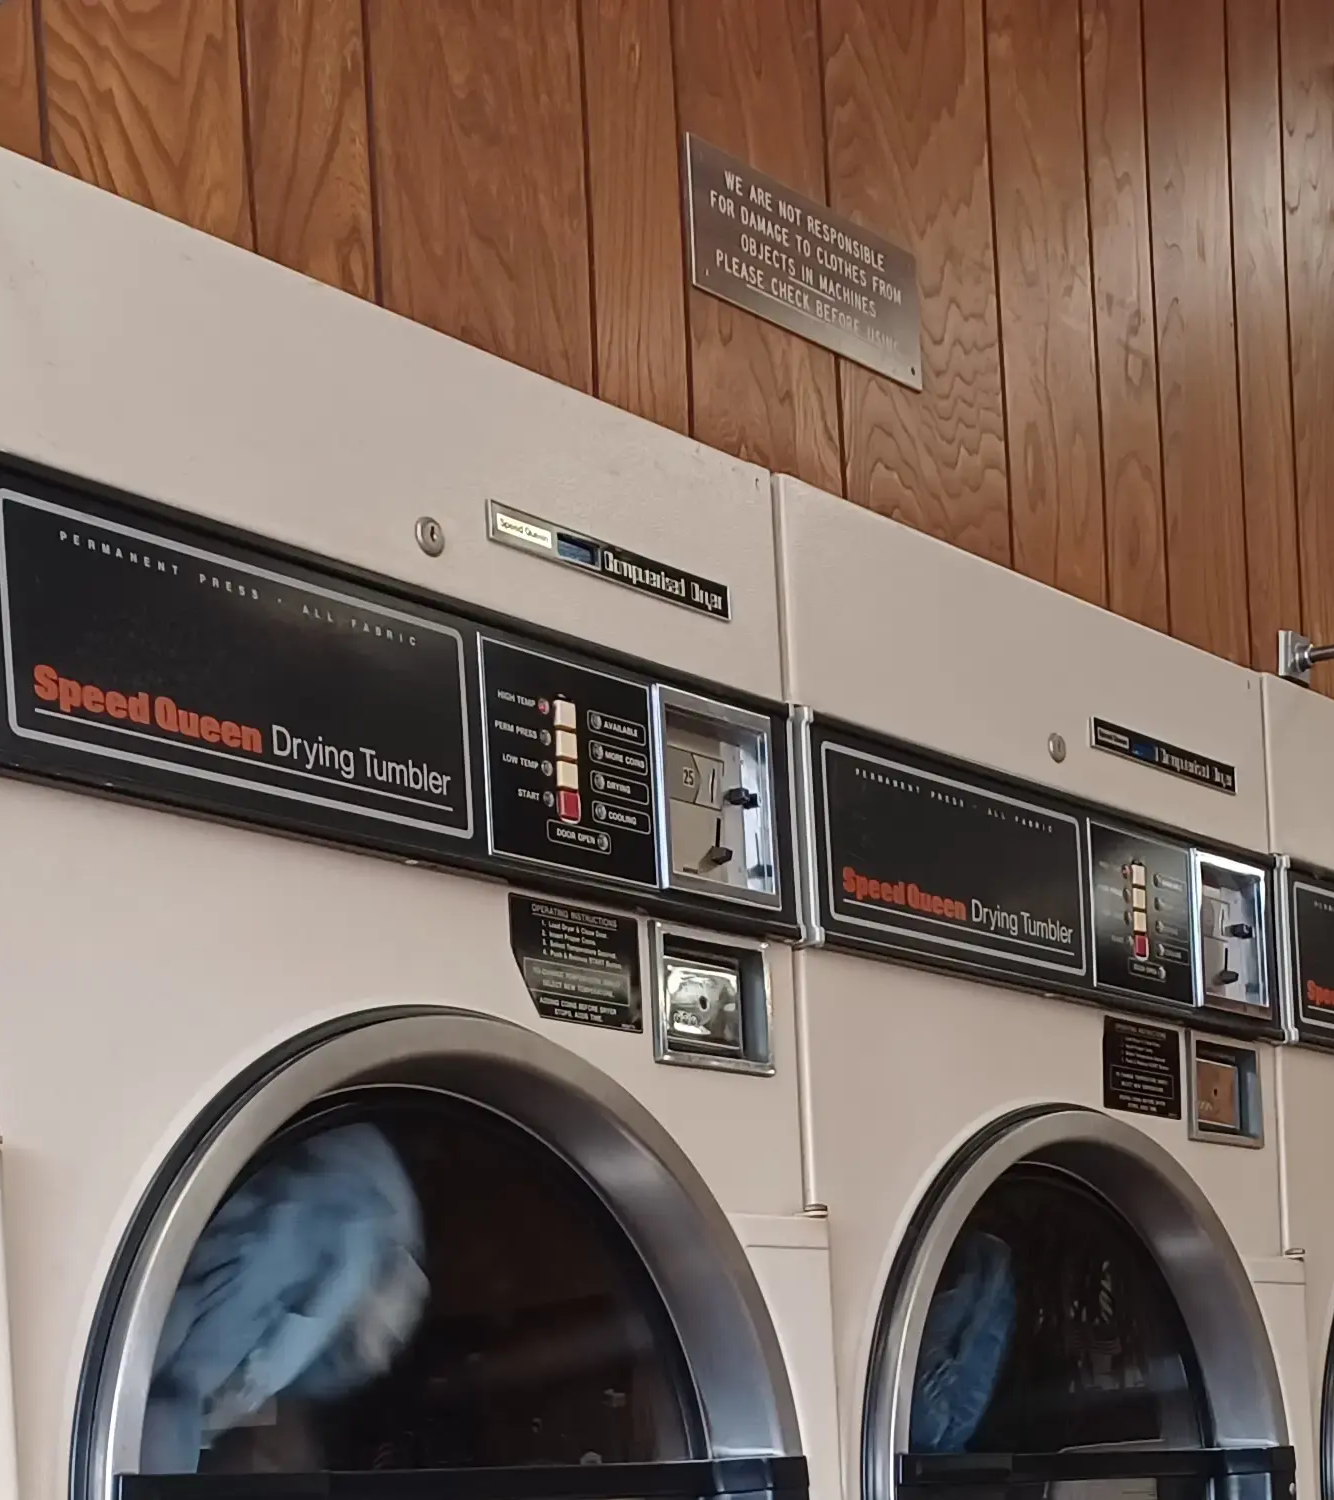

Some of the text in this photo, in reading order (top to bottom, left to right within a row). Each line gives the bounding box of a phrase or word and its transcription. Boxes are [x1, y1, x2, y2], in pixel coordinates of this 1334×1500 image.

[724, 170, 885, 273] WE ARE NOT RESPONSIBLE
[710, 190, 902, 305] FOR DAMAGE TO CLOTHES FROM
[716, 249, 765, 290] PLEASE
[771, 277, 811, 312] CHECK
[816, 299, 860, 334] BEFORE
[740, 233, 877, 318] OBJECTS IN MACHINES
[59, 530, 417, 646] PERMANENT PRESS ALL FABRIC
[494, 719, 514, 732] PERM
[517, 695, 536, 708] TEMP
[33, 664, 452, 797] Speed Queen Drying Tumbler
[604, 720, 639, 738] AVAILABLE
[502, 752, 539, 770] LOW TEMP
[683, 768, 694, 786] 25
[518, 788, 540, 801] START
[577, 833, 596, 845] OPEN
[842, 866, 1074, 945] Speed Queen Drying Tumbler
